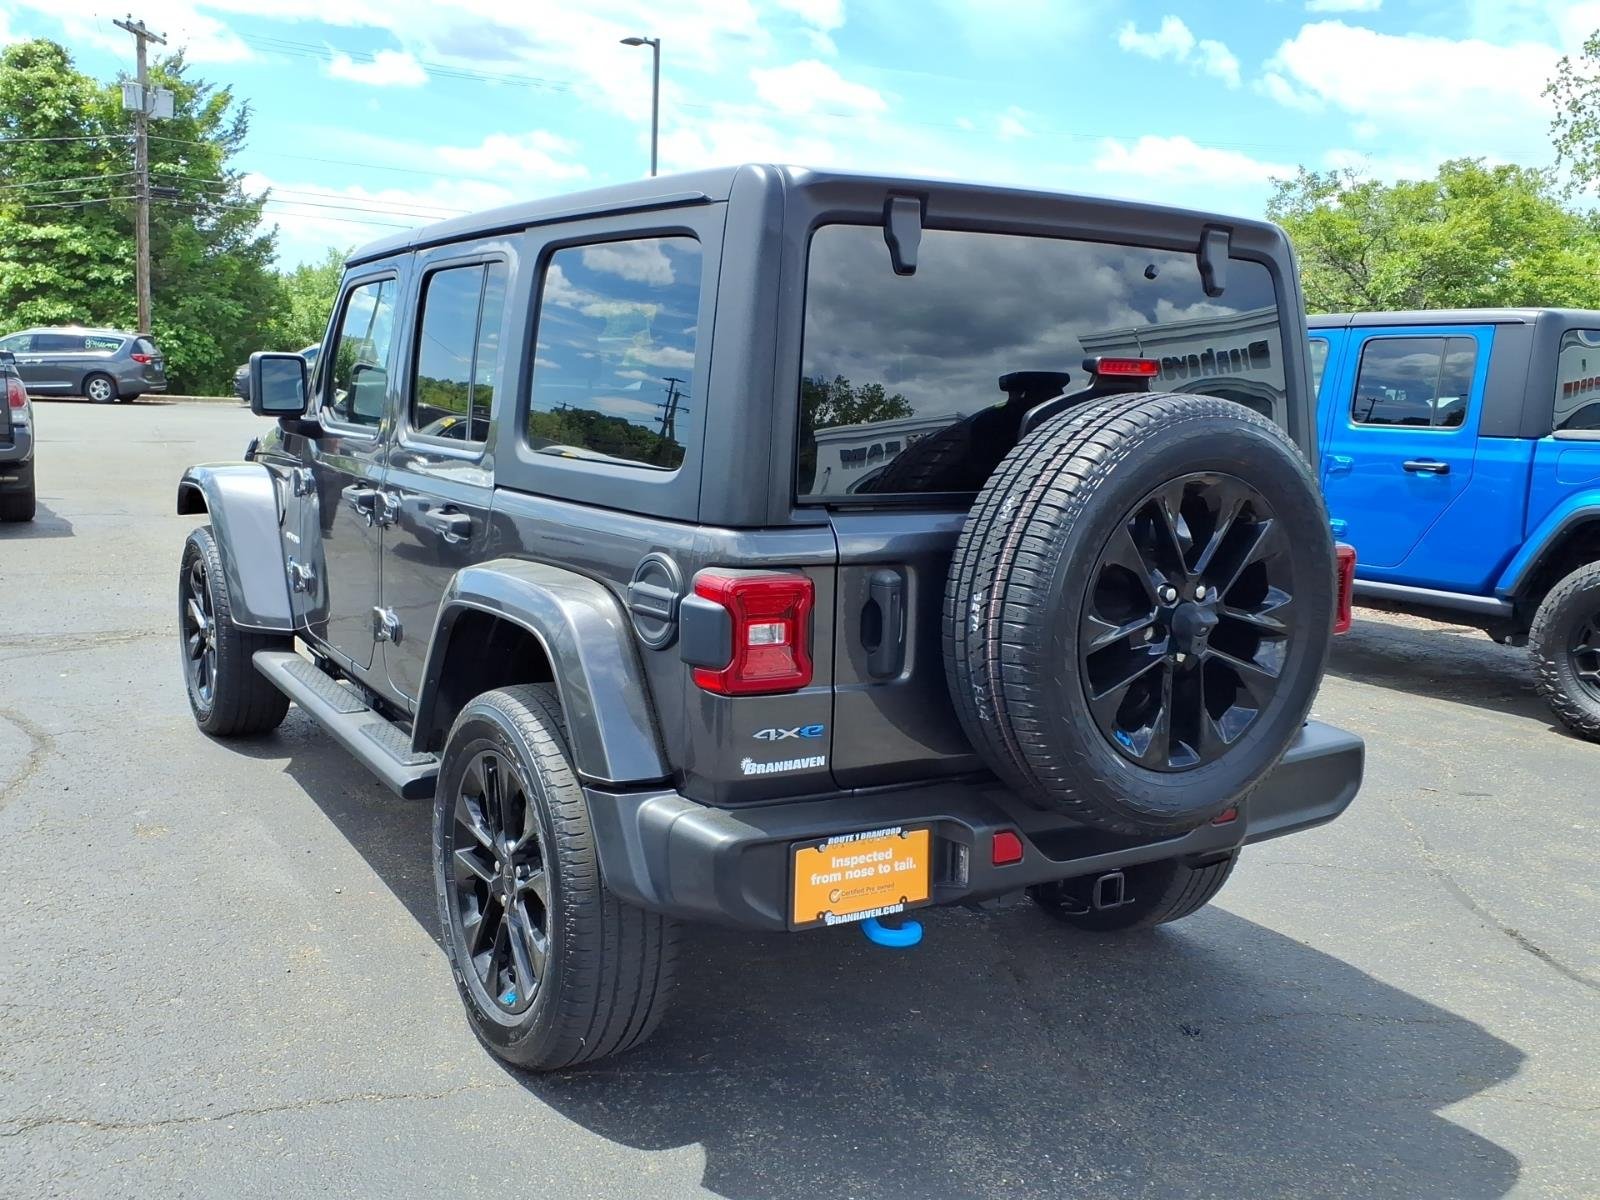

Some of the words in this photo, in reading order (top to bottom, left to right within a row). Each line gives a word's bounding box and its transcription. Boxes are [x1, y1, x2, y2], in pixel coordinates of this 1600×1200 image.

[742, 755, 826, 775] BRANHAVEN
[827, 834, 855, 845] ROUTE
[854, 833, 860, 842] 1
[860, 826, 902, 840] BRANFORD
[831, 848, 893, 868] Inspected
[810, 871, 842, 886] from
[845, 867, 875, 880] nose
[878, 862, 891, 874] to
[894, 856, 917, 872] tail.
[826, 903, 904, 926] BRANHAVEN.COM
